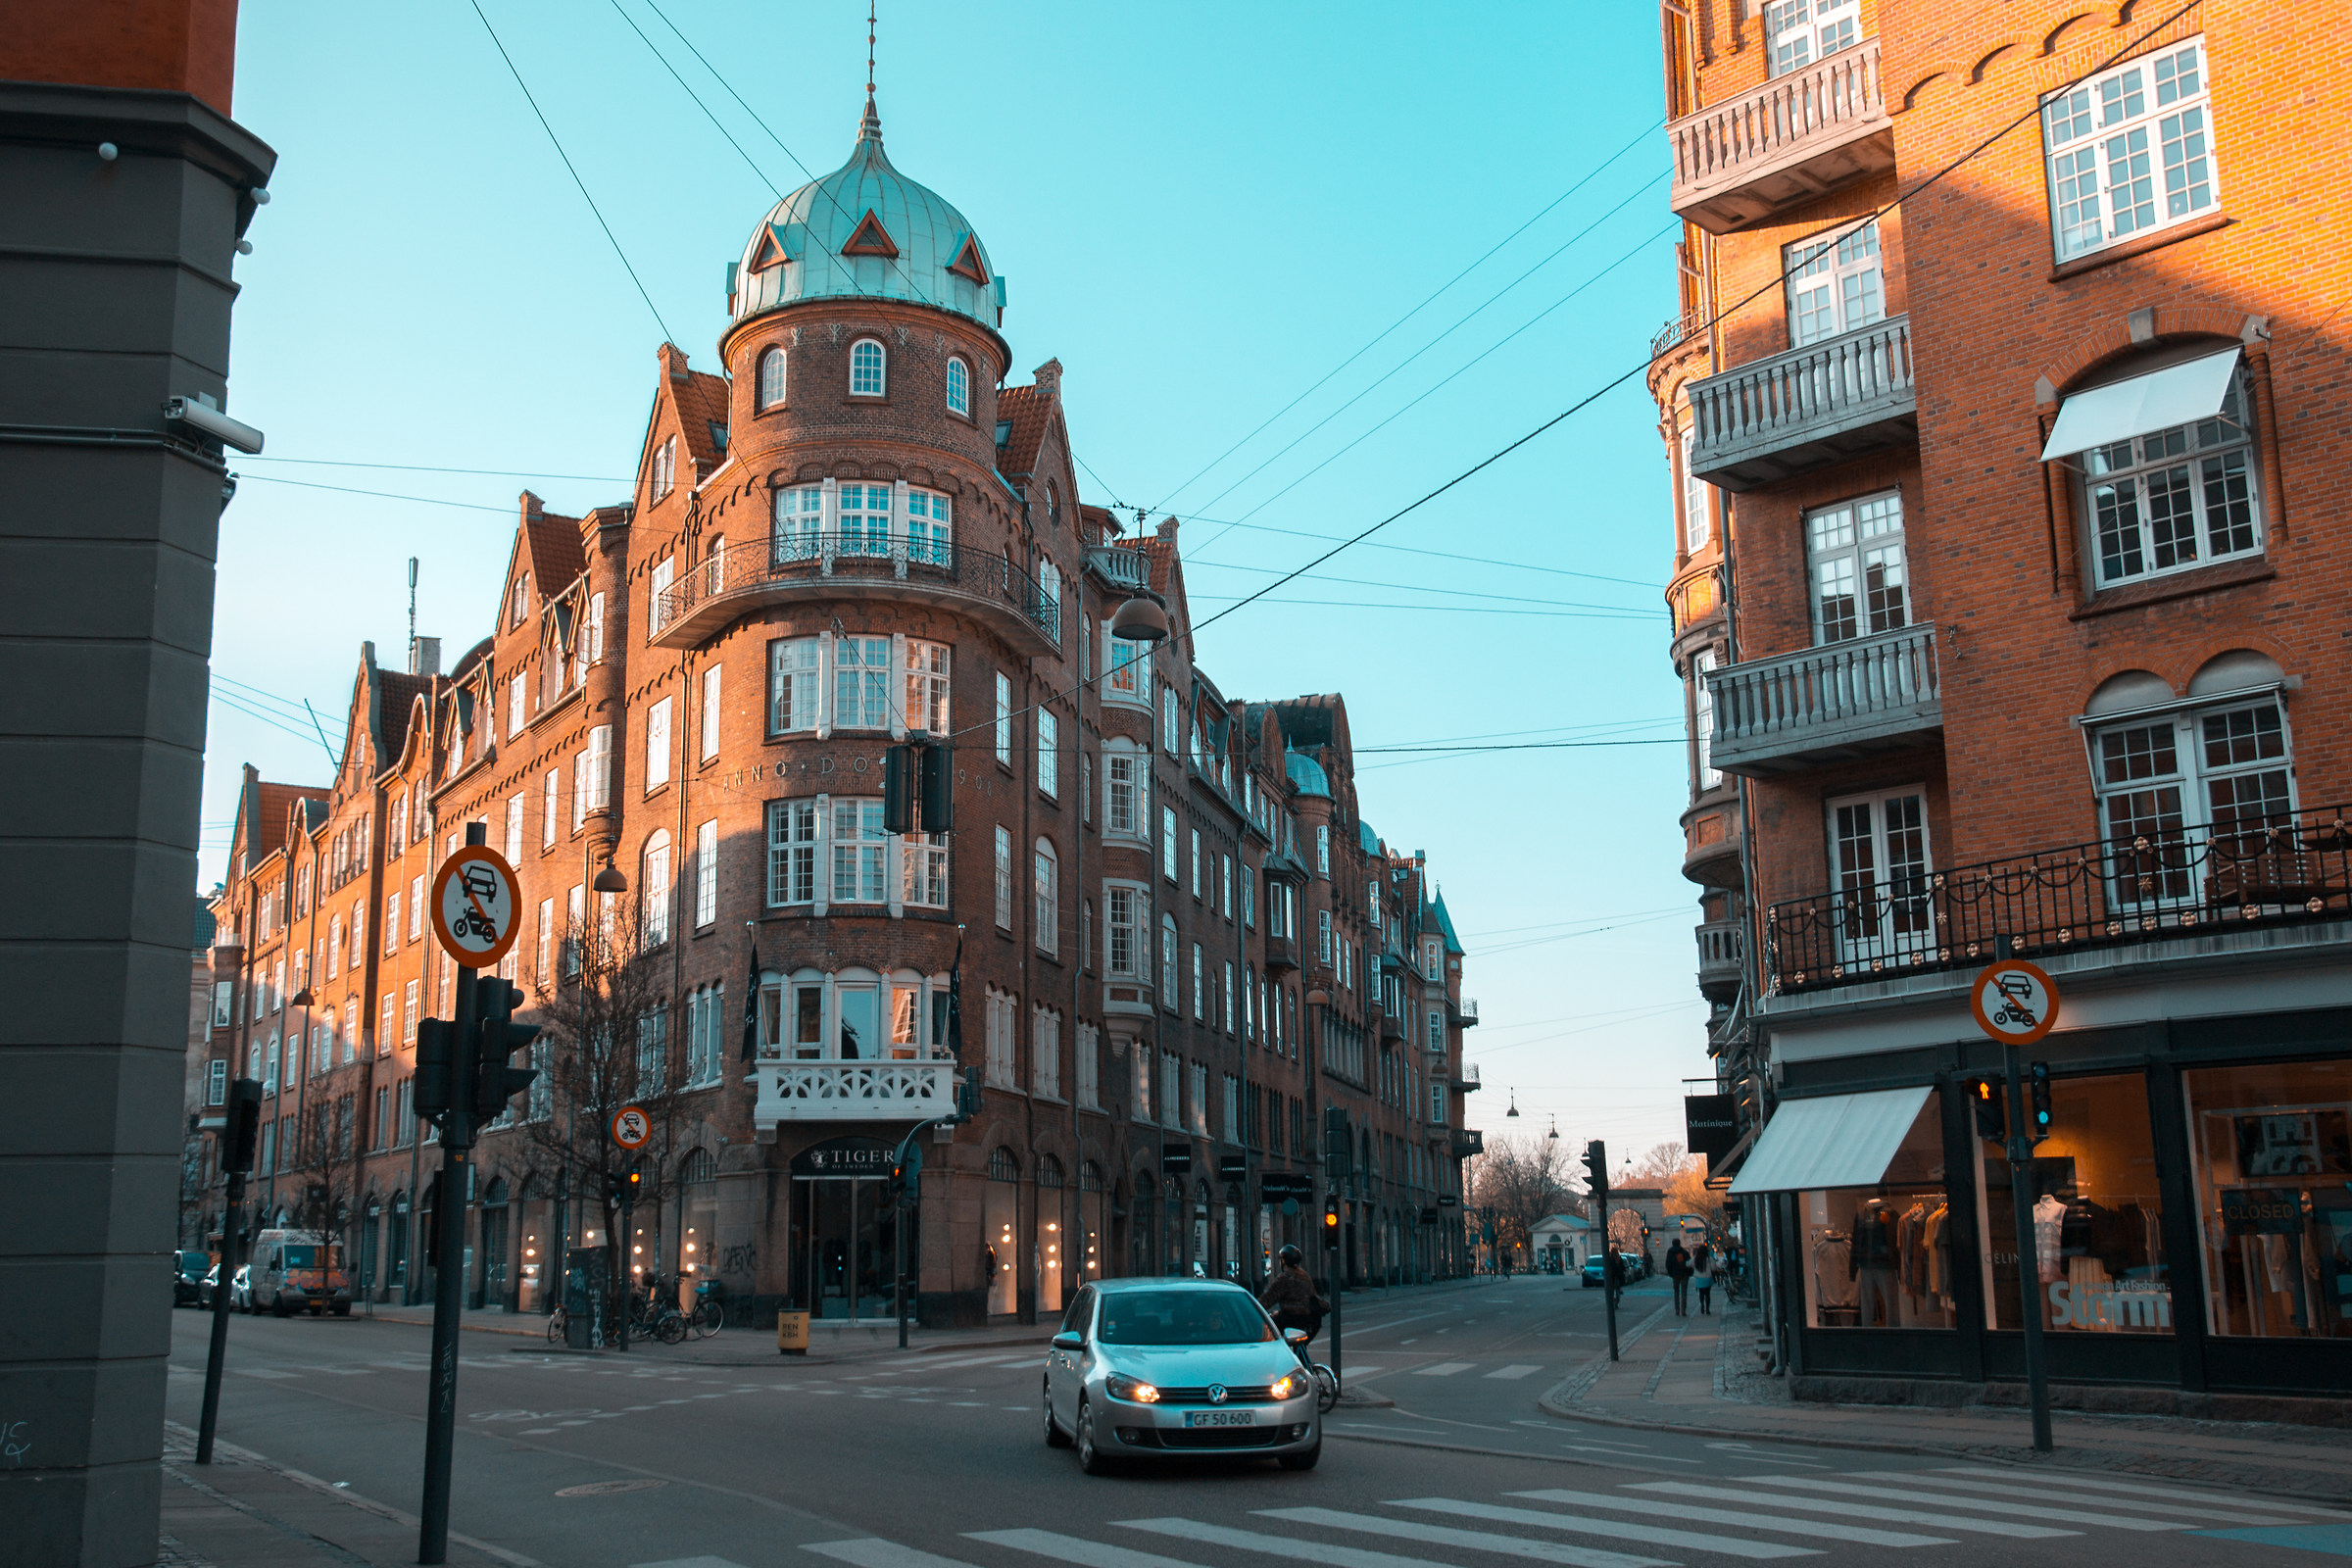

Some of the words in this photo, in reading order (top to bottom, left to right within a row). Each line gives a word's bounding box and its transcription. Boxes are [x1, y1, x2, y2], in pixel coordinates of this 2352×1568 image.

[722, 760, 787, 794] ANNO
[959, 768, 992, 797] 908
[831, 1150, 894, 1162] TIGER
[2228, 1203, 2294, 1220] CLOSED
[2115, 1280, 2130, 1291] Art
[2131, 1279, 2166, 1291] Fashion
[2048, 1281, 2171, 1327] Storm
[1194, 1414, 1208, 1425] GF
[1212, 1413, 1227, 1425] 50
[1230, 1413, 1251, 1425] 600
